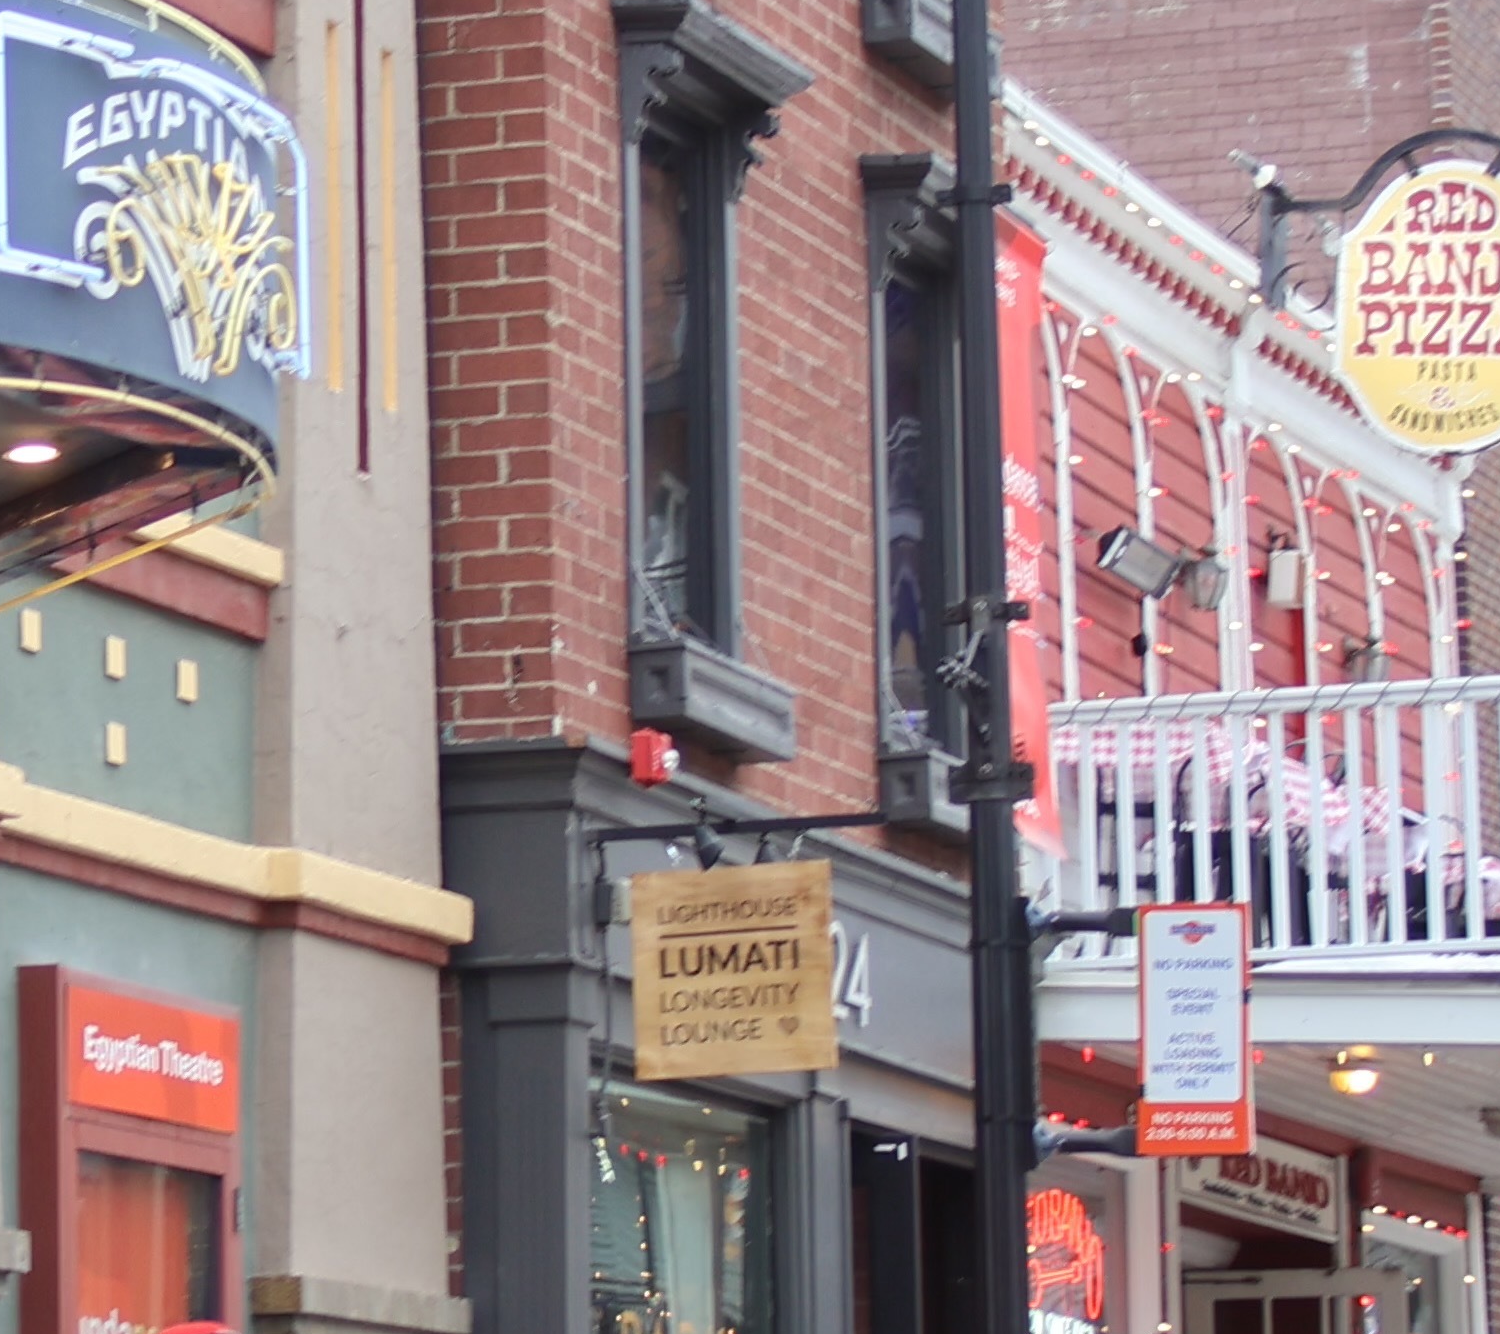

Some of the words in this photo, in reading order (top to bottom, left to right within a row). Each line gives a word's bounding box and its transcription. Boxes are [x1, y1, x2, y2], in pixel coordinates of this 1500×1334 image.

[1405, 181, 1496, 233] RED
[1417, 360, 1478, 382] PASTA
[1428, 386, 1456, 409] &
[1387, 403, 1500, 433] SANDWICHES
[657, 895, 798, 926] LIGHTHOUSE
[659, 939, 800, 979] LUMATI
[660, 982, 800, 1013] LONGEVITY
[660, 1018, 763, 1047] LOUNGE
[83, 1023, 159, 1075] Egyptian
[158, 1040, 224, 1087] Theatre
